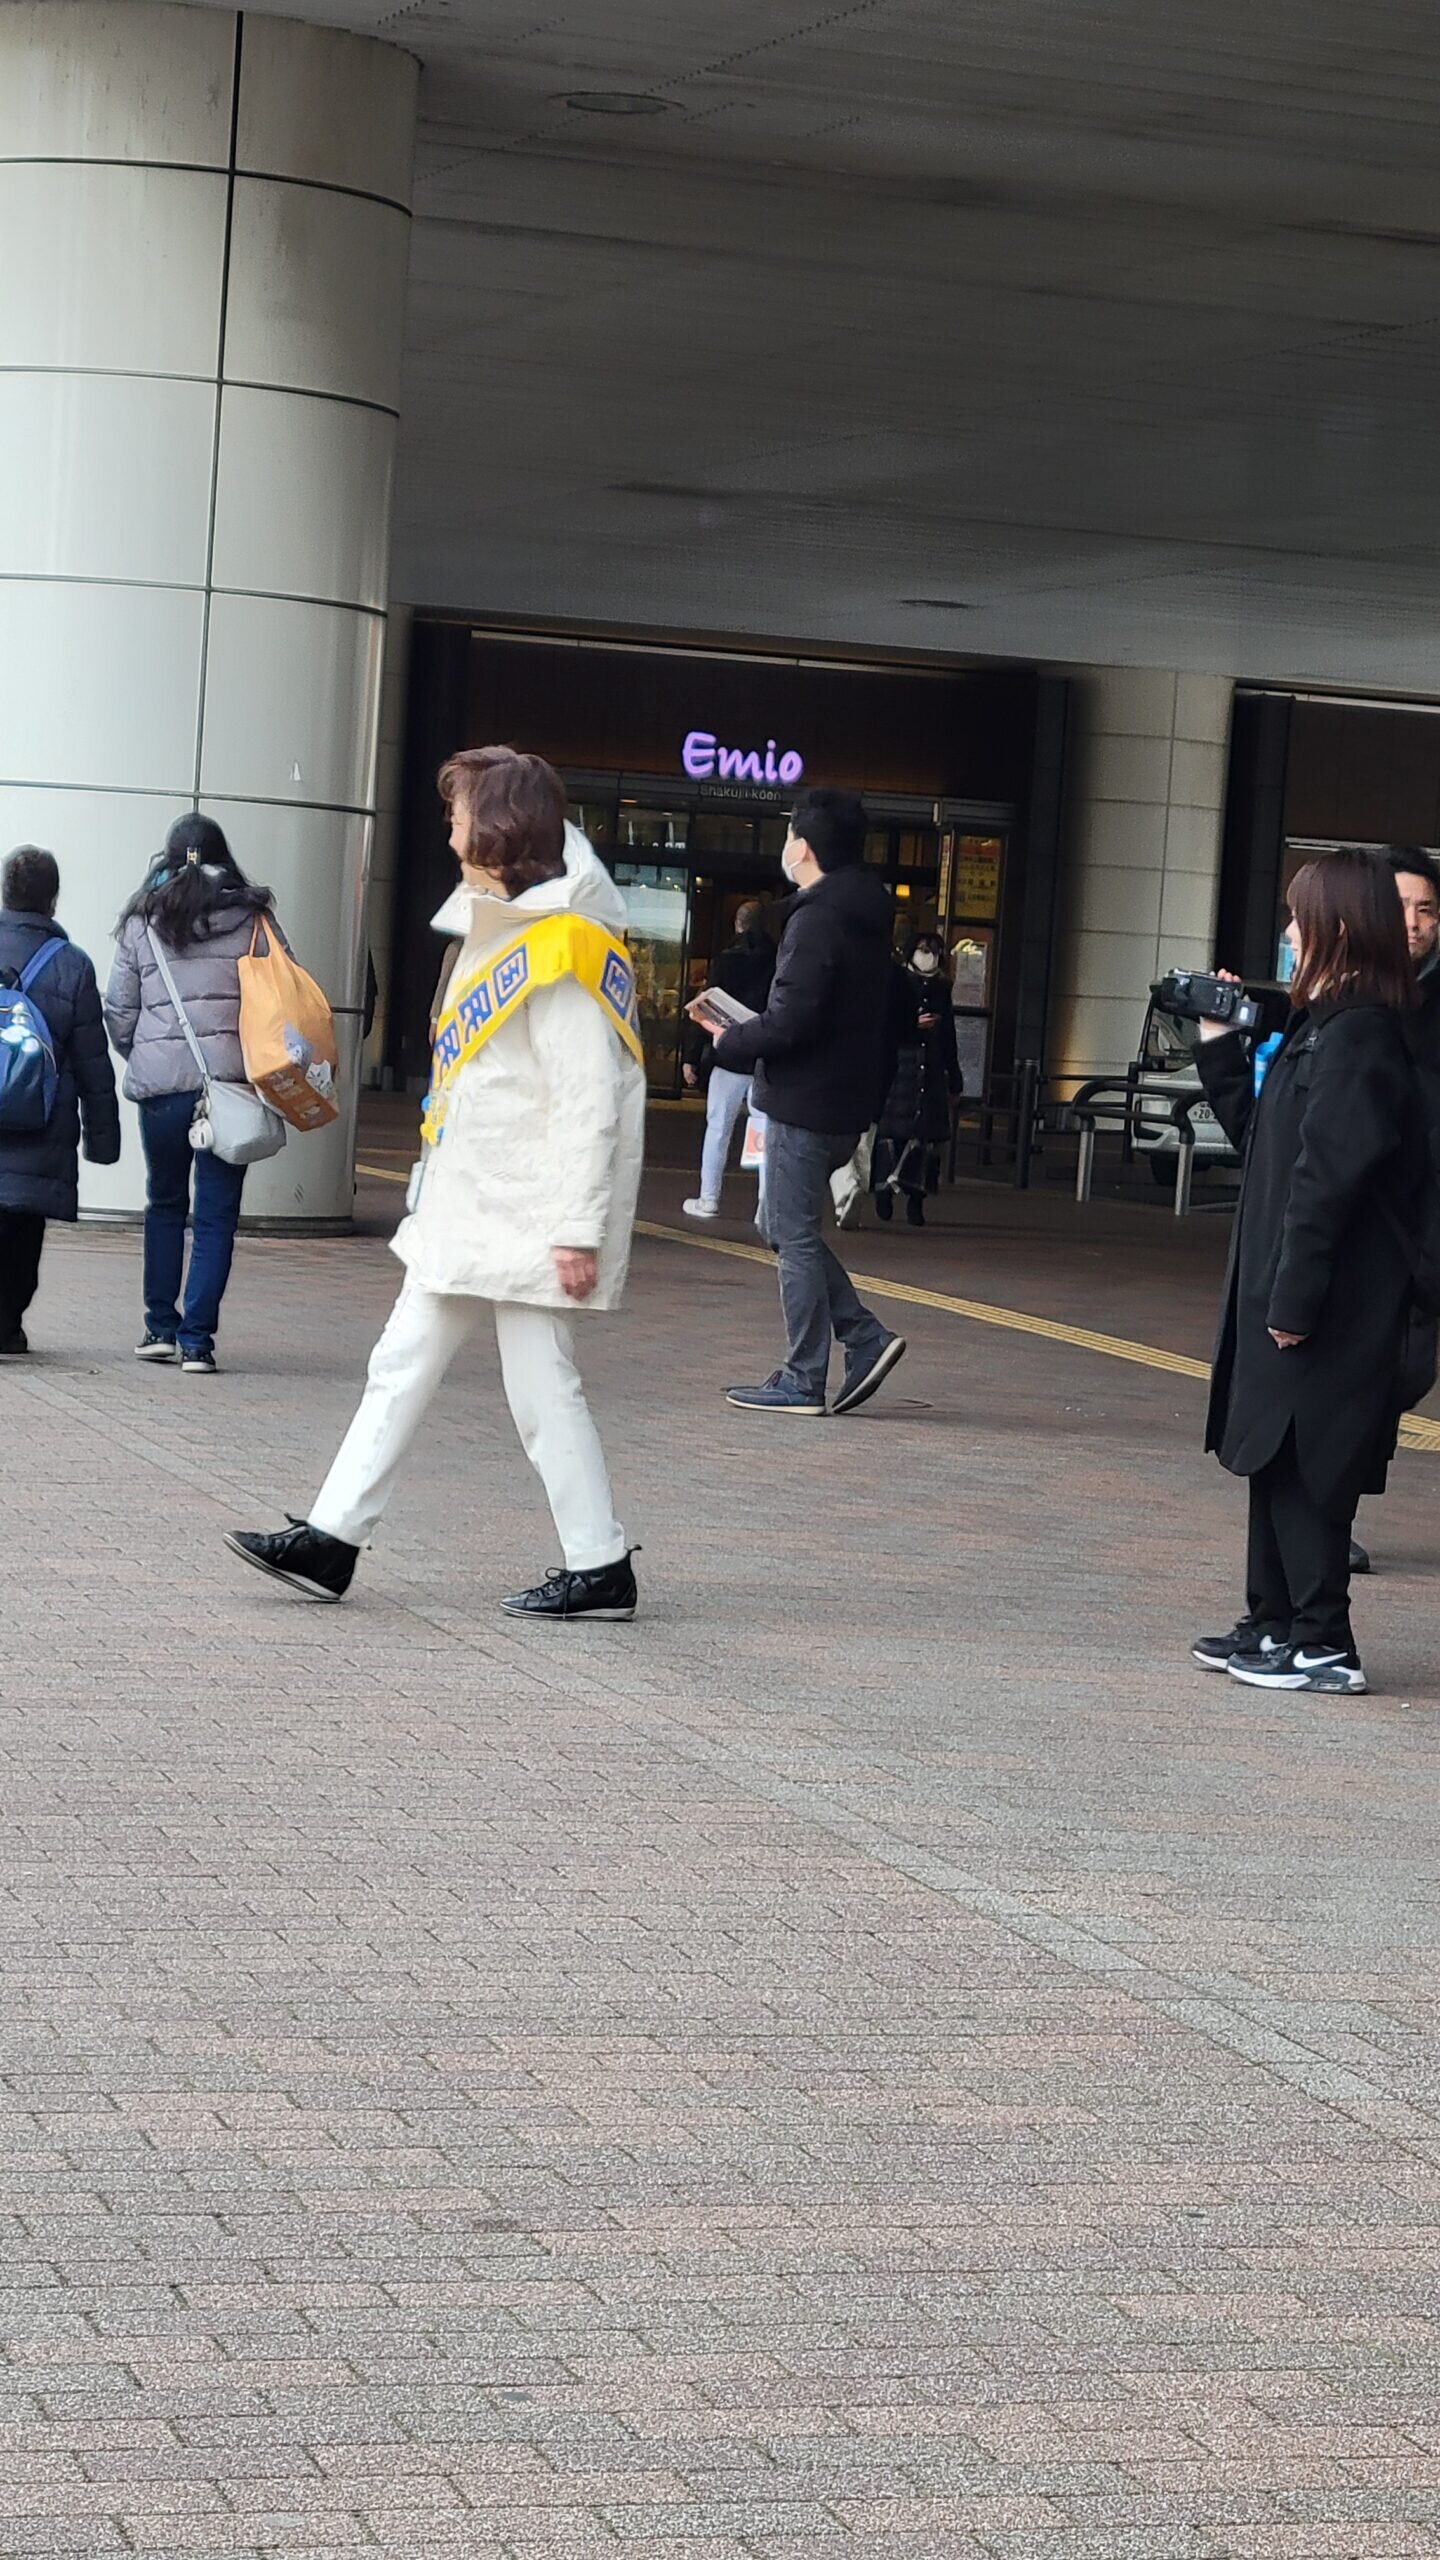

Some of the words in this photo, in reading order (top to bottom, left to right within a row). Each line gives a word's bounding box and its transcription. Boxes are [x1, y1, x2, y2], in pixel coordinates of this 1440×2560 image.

[682, 731, 803, 783] Emio
[429, 943, 529, 1084] 国民民
